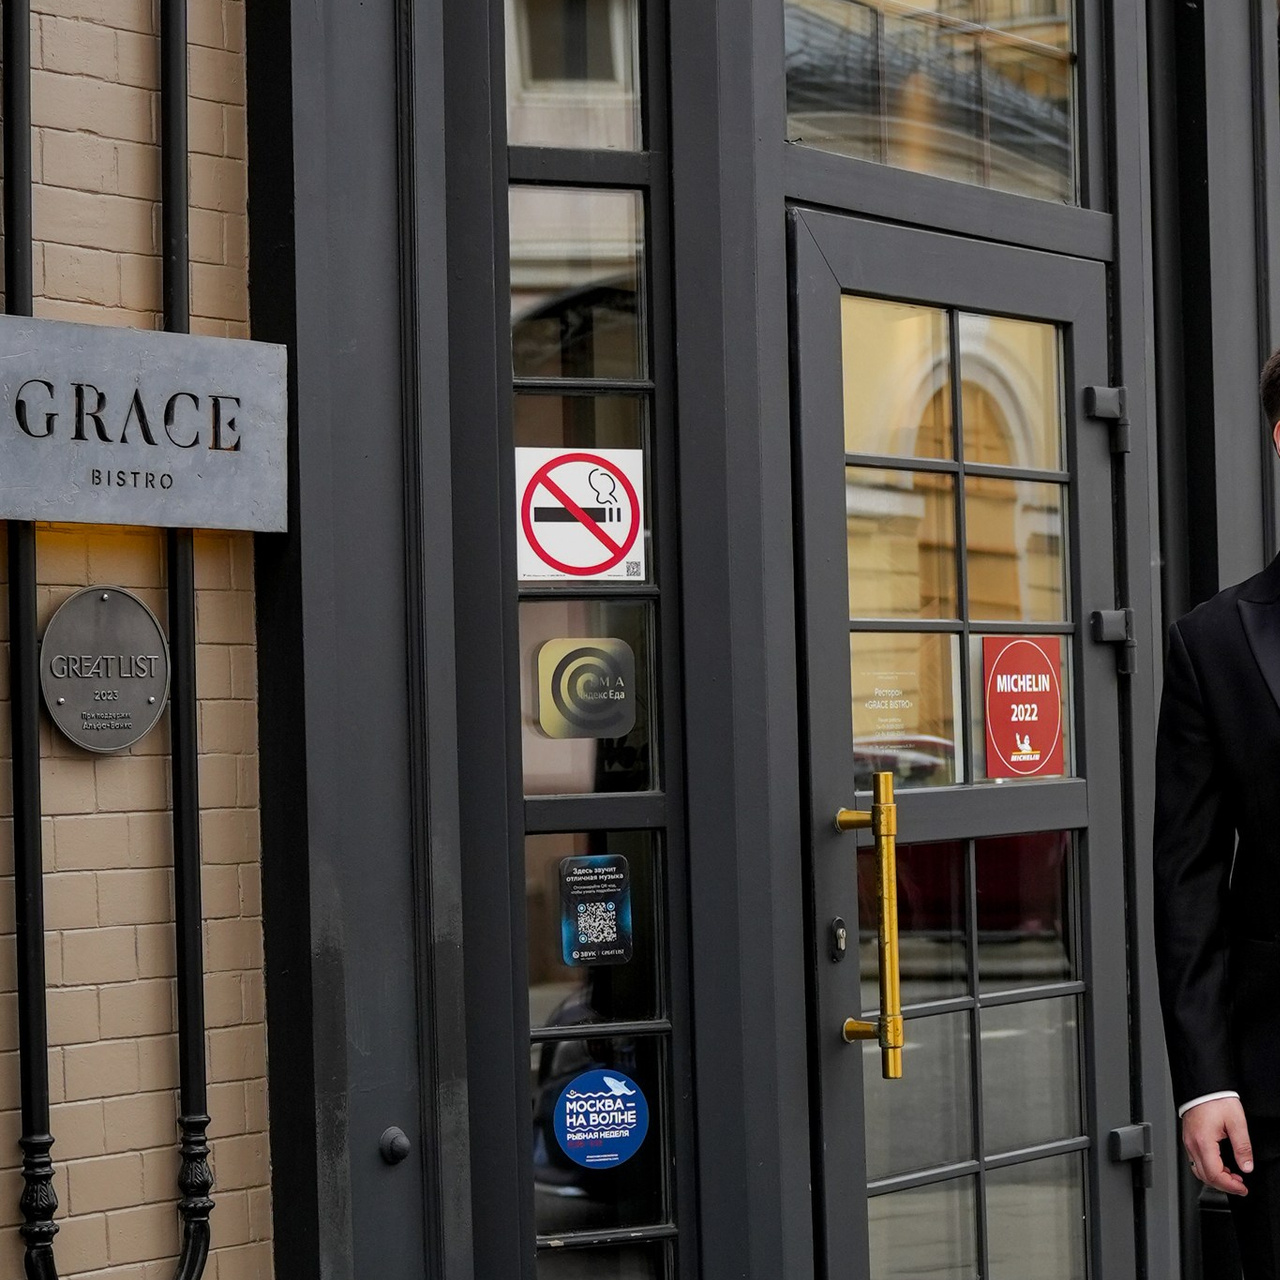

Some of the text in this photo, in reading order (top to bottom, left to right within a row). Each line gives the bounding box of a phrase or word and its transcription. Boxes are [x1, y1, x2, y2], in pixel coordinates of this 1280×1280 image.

[15, 379, 241, 452] GRACE
[91, 469, 173, 489] BISTRO
[50, 654, 159, 678] GREAT LIST
[996, 674, 1050, 693] MICHELIN
[93, 690, 119, 701] 2023
[608, 690, 625, 700] Еда
[1010, 703, 1038, 722] 2022
[572, 866, 617, 875] Здесь звучит
[598, 873, 624, 881] музыка
[566, 1098, 625, 1114] МОСКВА
[566, 1110, 637, 1127] НА ВОЛНЕ
[566, 1129, 630, 1141] РЫБНАЯ НЕДЕЛЯ
